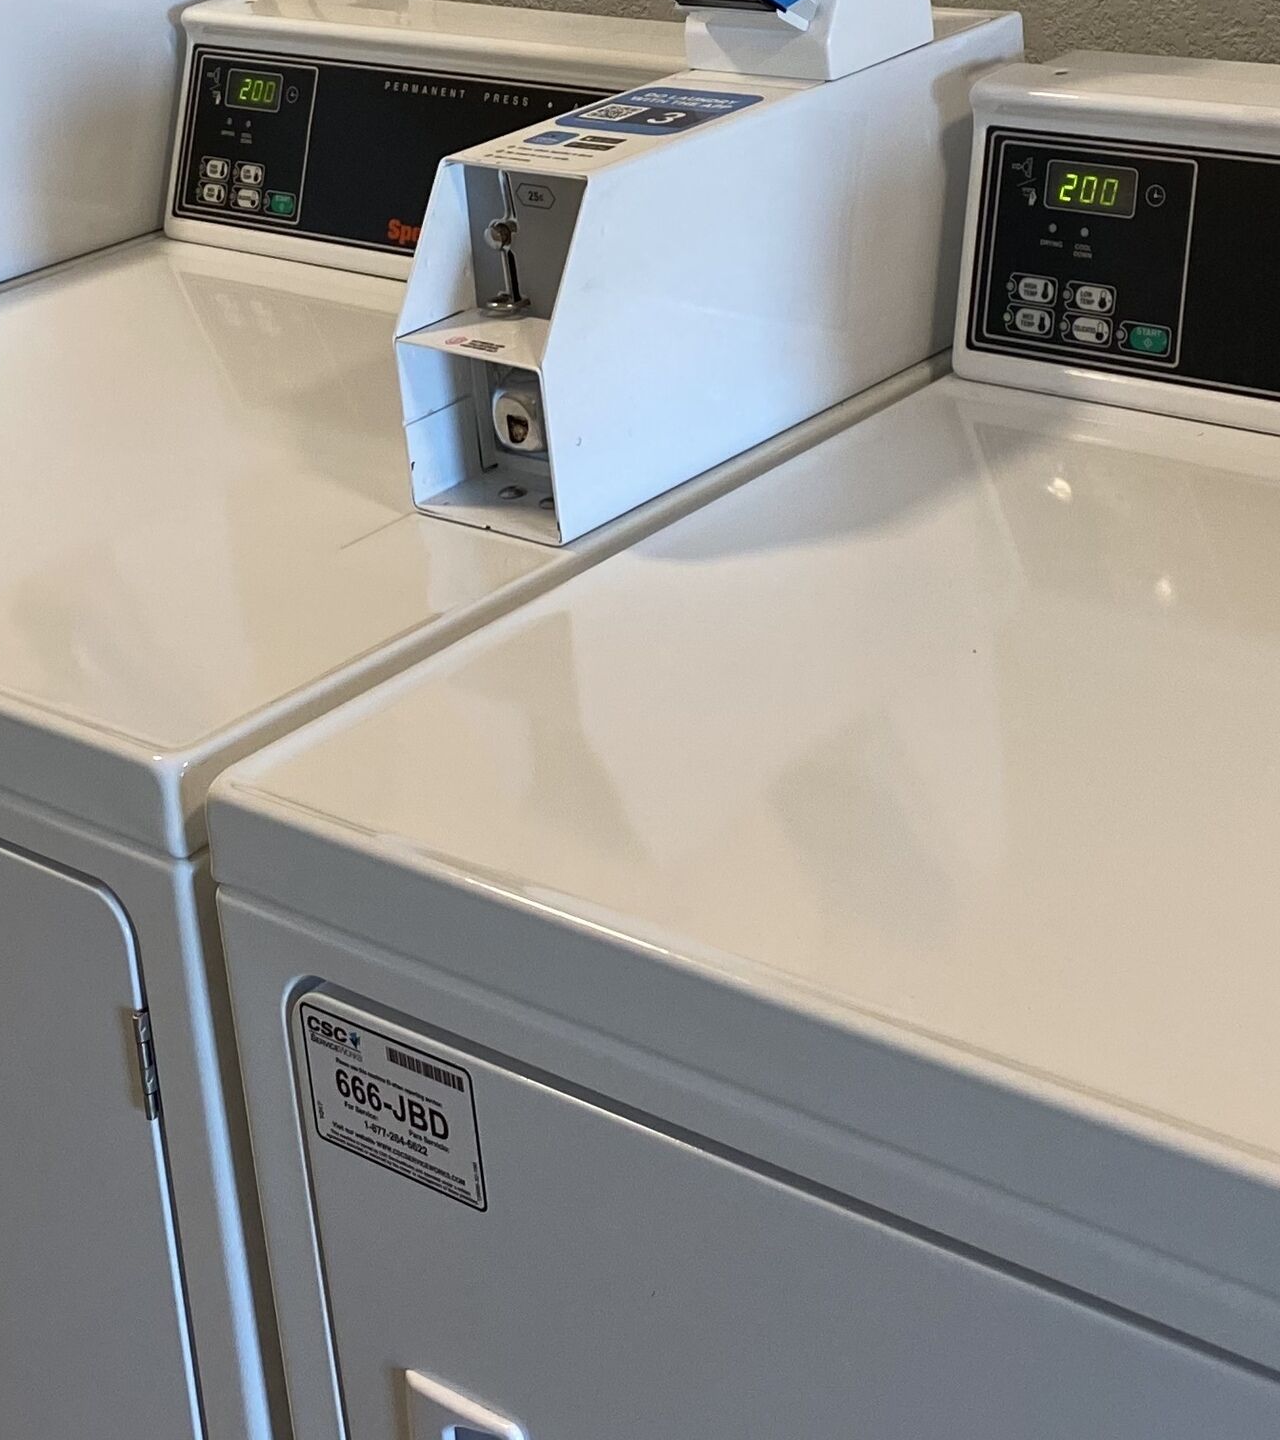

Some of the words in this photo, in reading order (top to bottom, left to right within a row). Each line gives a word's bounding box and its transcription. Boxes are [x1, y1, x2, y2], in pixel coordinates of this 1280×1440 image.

[239, 78, 277, 102] 200
[384, 80, 466, 99] PERMANENT
[484, 92, 530, 107] PRESS
[668, 94, 741, 105] LAUNDRY
[646, 112, 687, 124] 3
[1058, 173, 1119, 206] 200
[1136, 328, 1163, 337] START
[306, 1015, 348, 1043] CSC
[335, 1068, 449, 1140] 666-JBD
